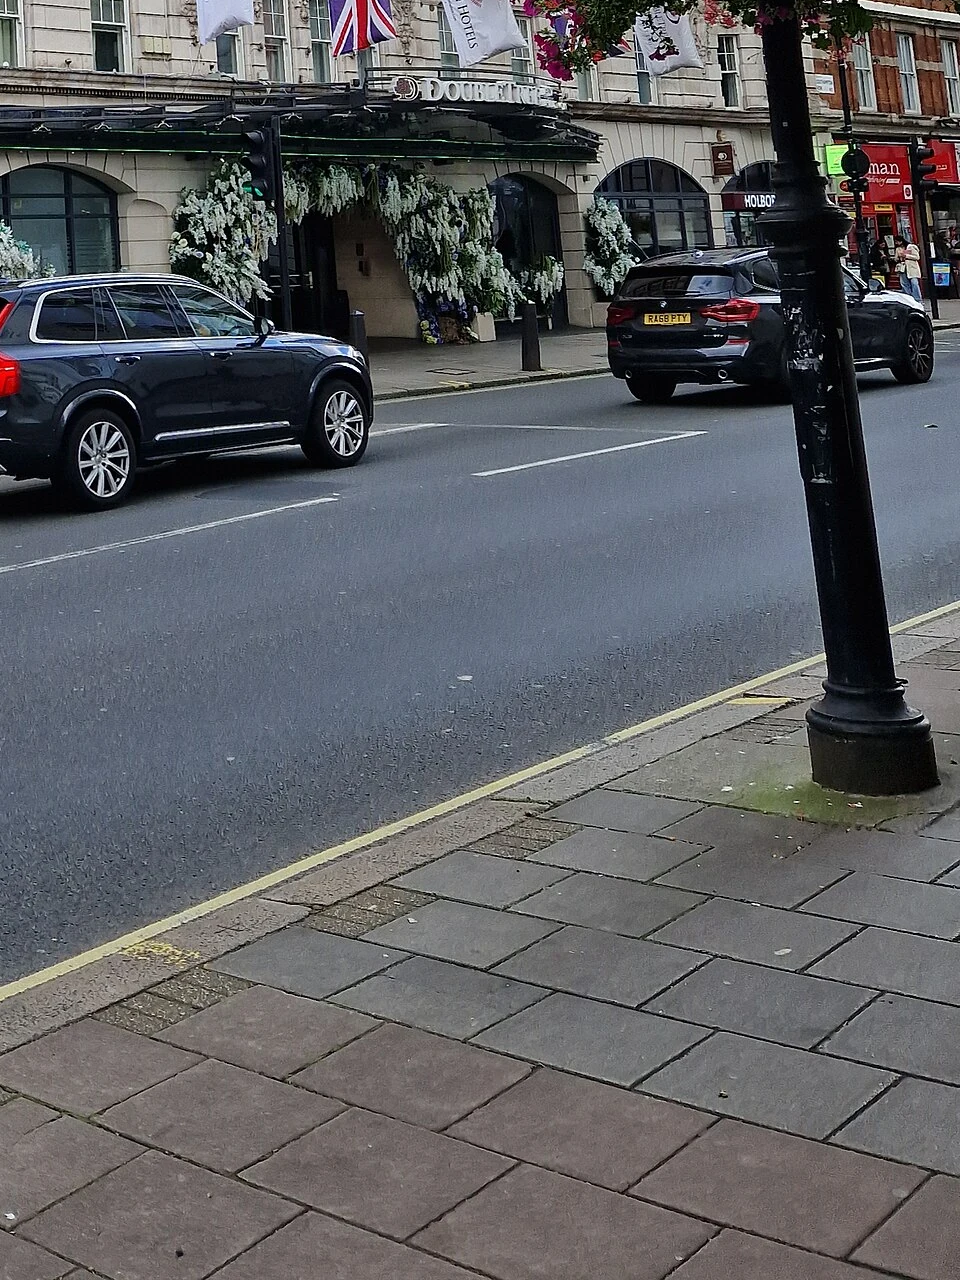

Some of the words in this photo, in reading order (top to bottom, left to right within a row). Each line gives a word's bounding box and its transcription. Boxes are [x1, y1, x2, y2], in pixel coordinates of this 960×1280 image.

[457, 5, 478, 49] HOTELS
[868, 162, 900, 175] man
[744, 194, 776, 208] HOLBO
[671, 314, 688, 322] PTY
